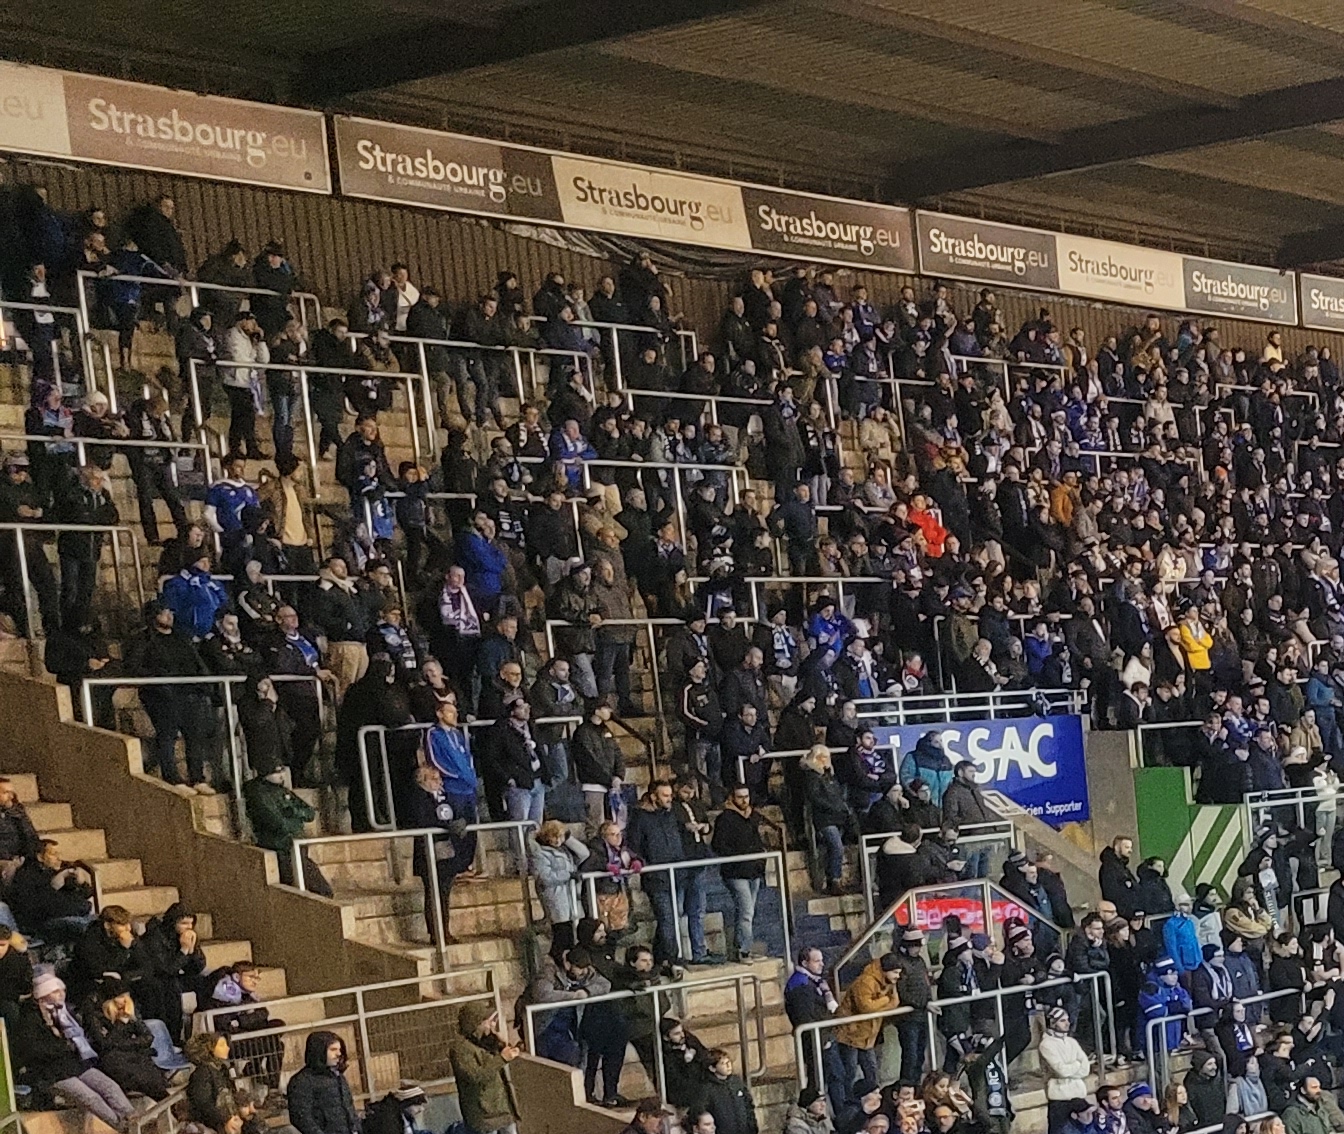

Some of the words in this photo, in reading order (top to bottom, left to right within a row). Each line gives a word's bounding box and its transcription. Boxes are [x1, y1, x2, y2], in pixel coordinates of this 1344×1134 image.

[356, 139, 543, 203] Strasbourg.eu
[572, 176, 733, 232] Strasbourg.eu
[758, 204, 901, 256] Strasbourg.eu
[928, 228, 1049, 276] Strasbourg.eu
[1046, 800, 1083, 815] Supporter
